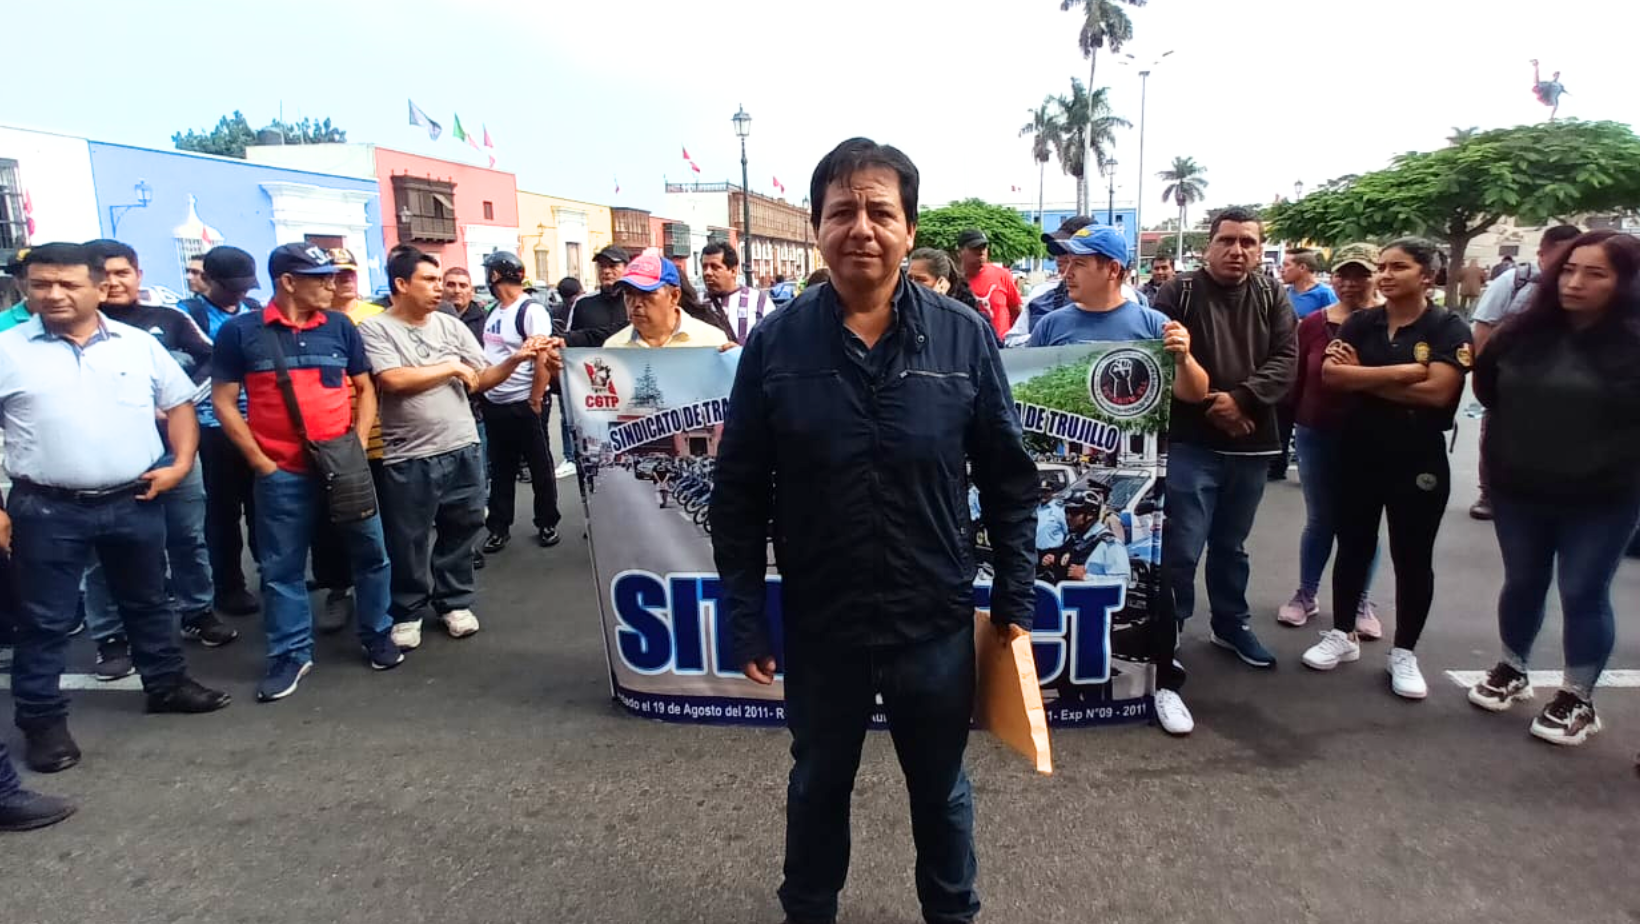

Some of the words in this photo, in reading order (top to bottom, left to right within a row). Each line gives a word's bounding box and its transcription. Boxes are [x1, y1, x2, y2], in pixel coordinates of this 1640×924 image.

[585, 395, 620, 408] CGTP
[609, 410, 682, 452] SINDICATO
[682, 405, 703, 429] DE
[702, 396, 730, 424] TRA
[1024, 404, 1047, 431] DE
[1048, 410, 1119, 451] TRUJILLO
[641, 701, 651, 712] el
[653, 702, 665, 714] 19
[667, 702, 681, 714] de
[683, 702, 722, 719] Agosto
[724, 704, 742, 717] del
[776, 707, 785, 720] R
[1060, 708, 1083, 722] Exp
[1122, 703, 1147, 717] 2011
